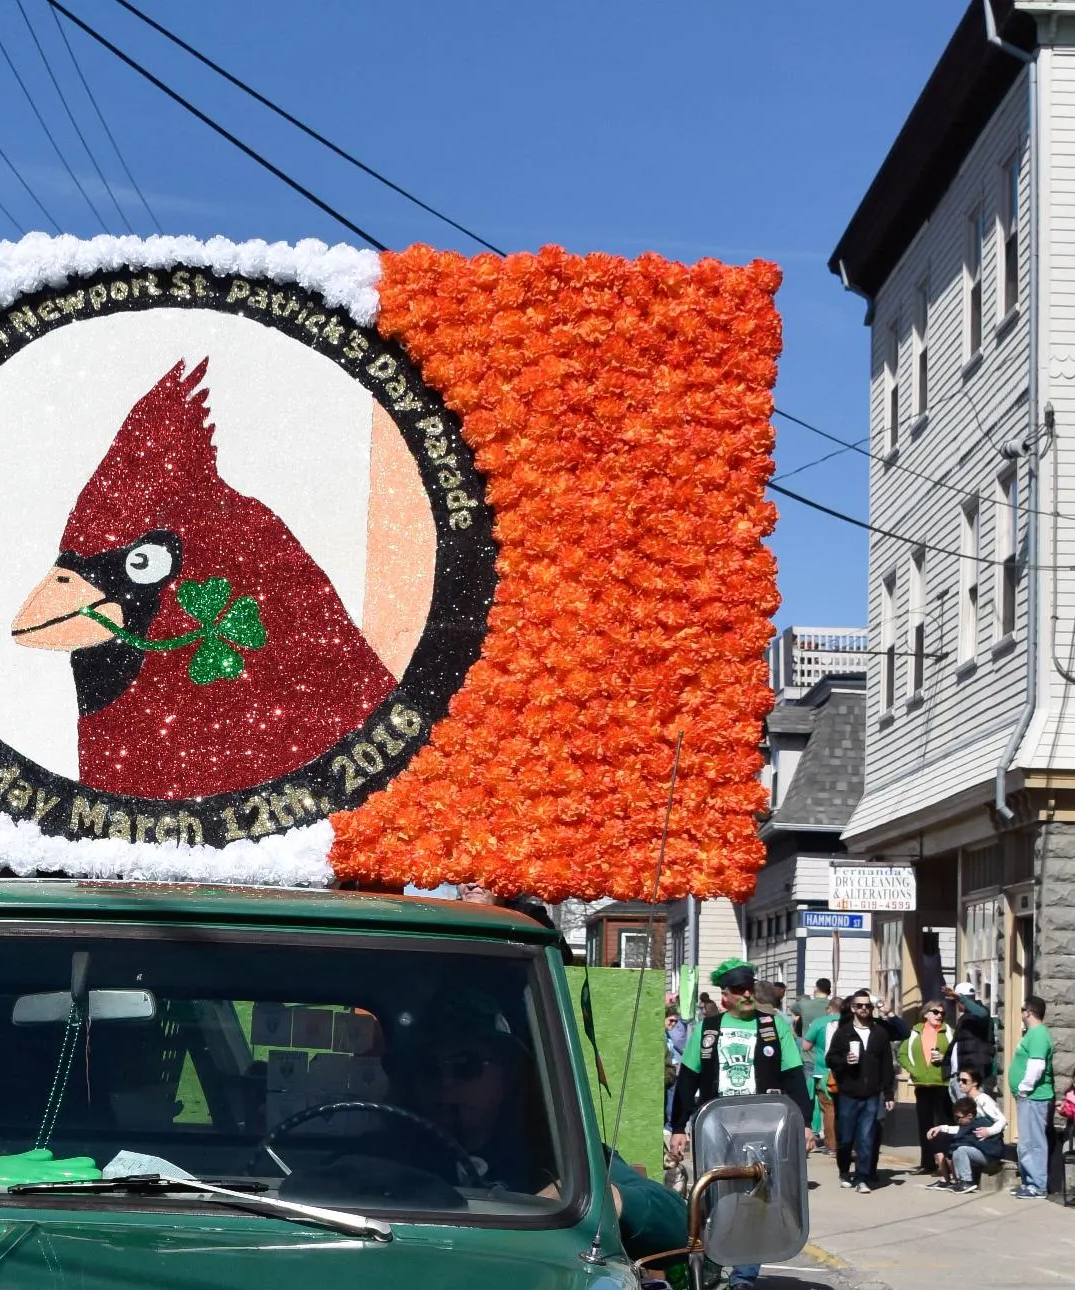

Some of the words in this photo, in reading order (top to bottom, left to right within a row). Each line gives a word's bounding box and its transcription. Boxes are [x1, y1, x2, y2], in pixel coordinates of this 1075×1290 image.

[8, 272, 162, 333] Newport
[226, 279, 369, 359] Patrick's
[365, 353, 423, 411] Day
[415, 415, 478, 531] Parade
[70, 795, 203, 844] March
[331, 702, 422, 794] 2016
[835, 877, 854, 888] DRY
[857, 877, 910, 888] CLEANING
[833, 888, 840, 899] &
[844, 889, 912, 900] ALTERATIONS
[806, 914, 850, 927] HAMMOND
[853, 919, 861, 928] ST
